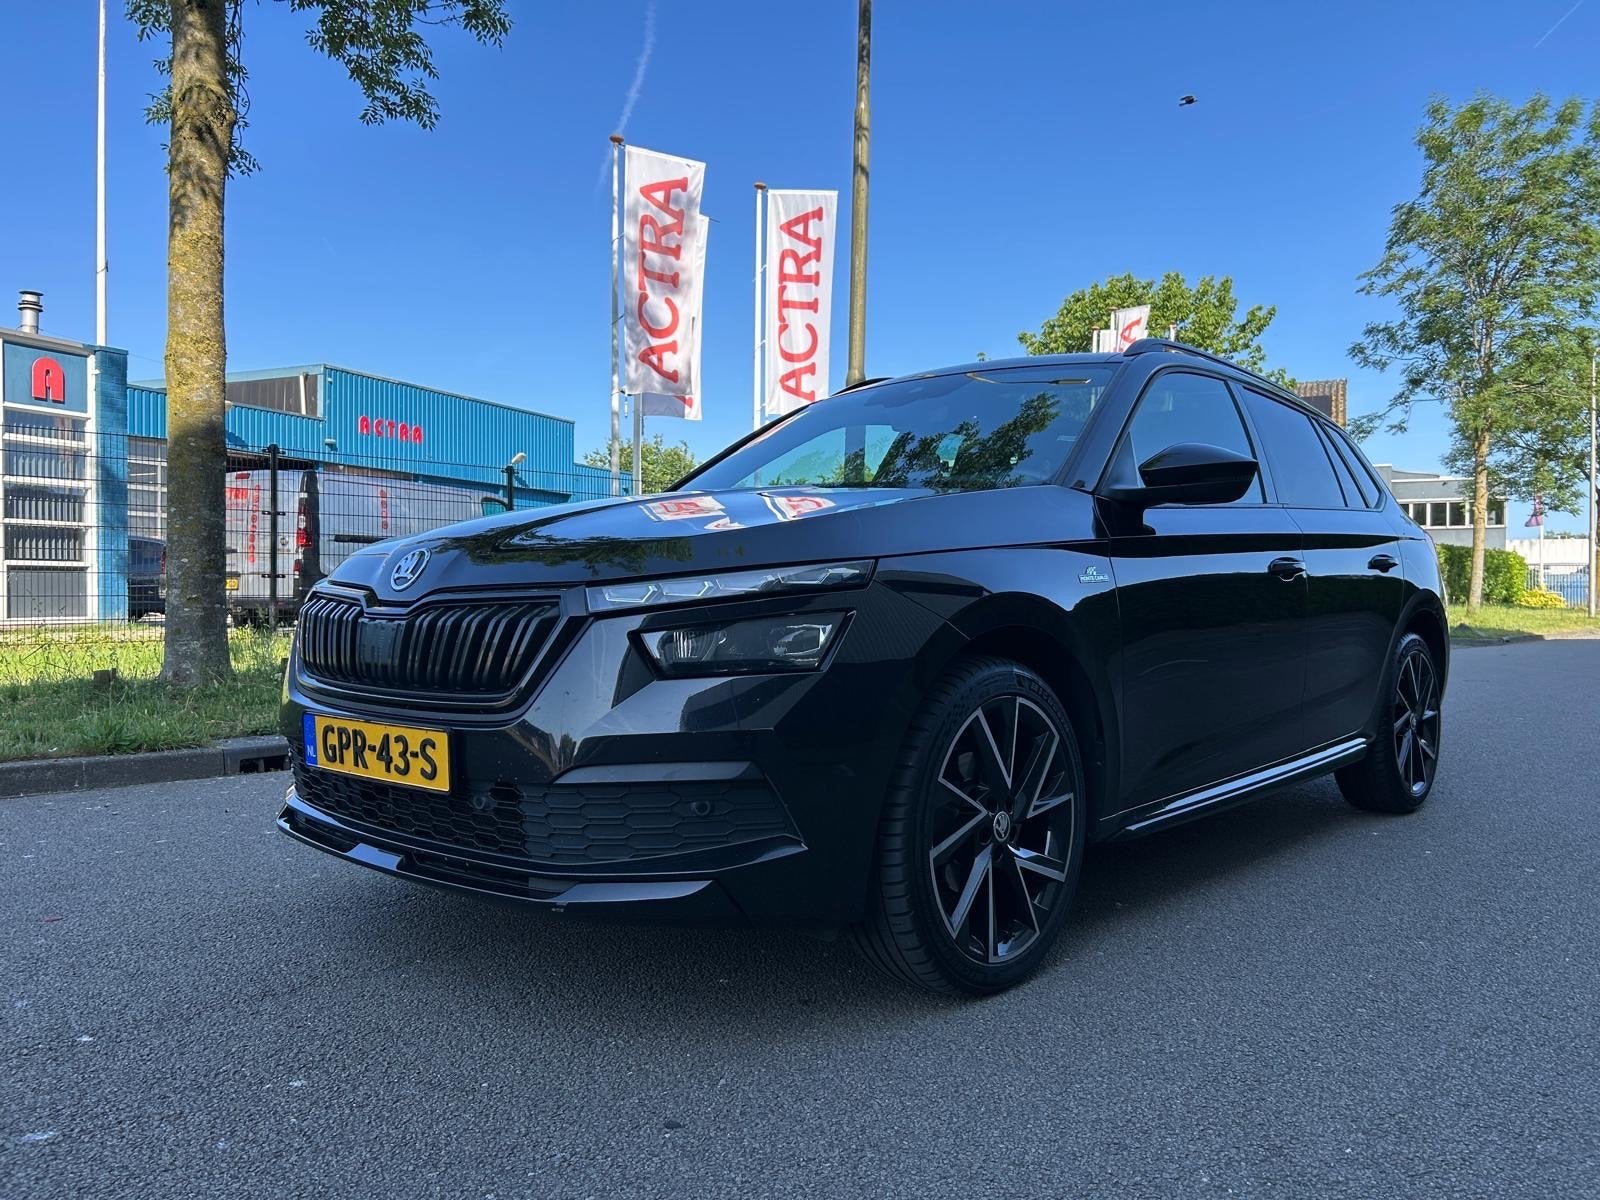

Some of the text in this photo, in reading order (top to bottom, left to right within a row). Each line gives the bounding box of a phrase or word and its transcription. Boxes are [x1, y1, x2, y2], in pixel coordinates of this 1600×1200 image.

[637, 176, 689, 384] ACTRA
[777, 206, 824, 402] ACTRA
[32, 357, 65, 403] A
[359, 415, 423, 444] ACTRA
[322, 724, 438, 781] GPR-43-S
